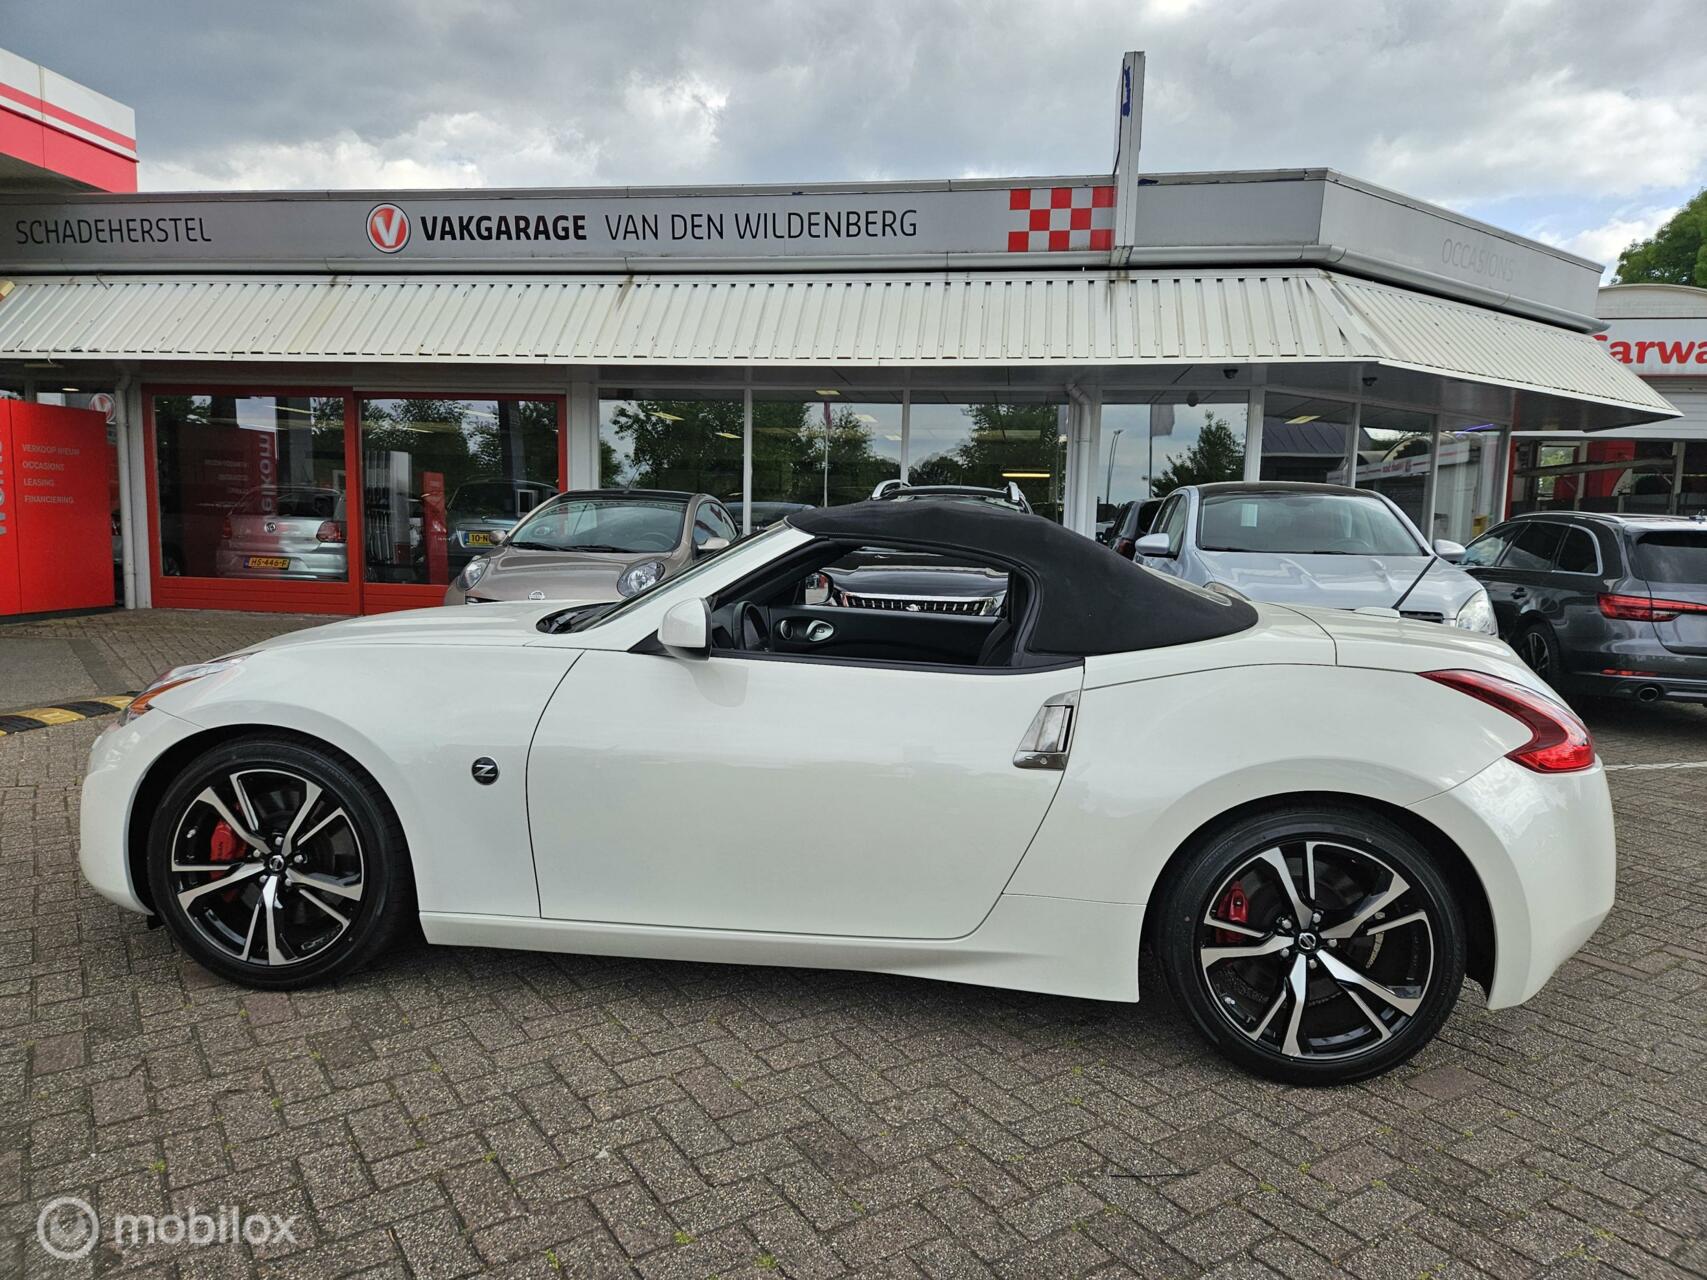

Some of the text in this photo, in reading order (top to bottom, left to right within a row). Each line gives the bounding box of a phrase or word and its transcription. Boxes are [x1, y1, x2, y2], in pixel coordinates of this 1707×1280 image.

[16, 217, 211, 245] SCHADEHERSTEL
[421, 214, 588, 241] VAKGARAGE
[605, 213, 659, 241] VAN
[672, 213, 725, 241] DEN
[736, 209, 918, 239] WILDENBERG
[1441, 238, 1514, 282] OCCASIONS
[1592, 334, 1707, 364] arwa
[22, 444, 56, 454] VERKOOP
[22, 460, 65, 471] OCCASIONS
[23, 477, 55, 487] LEASING
